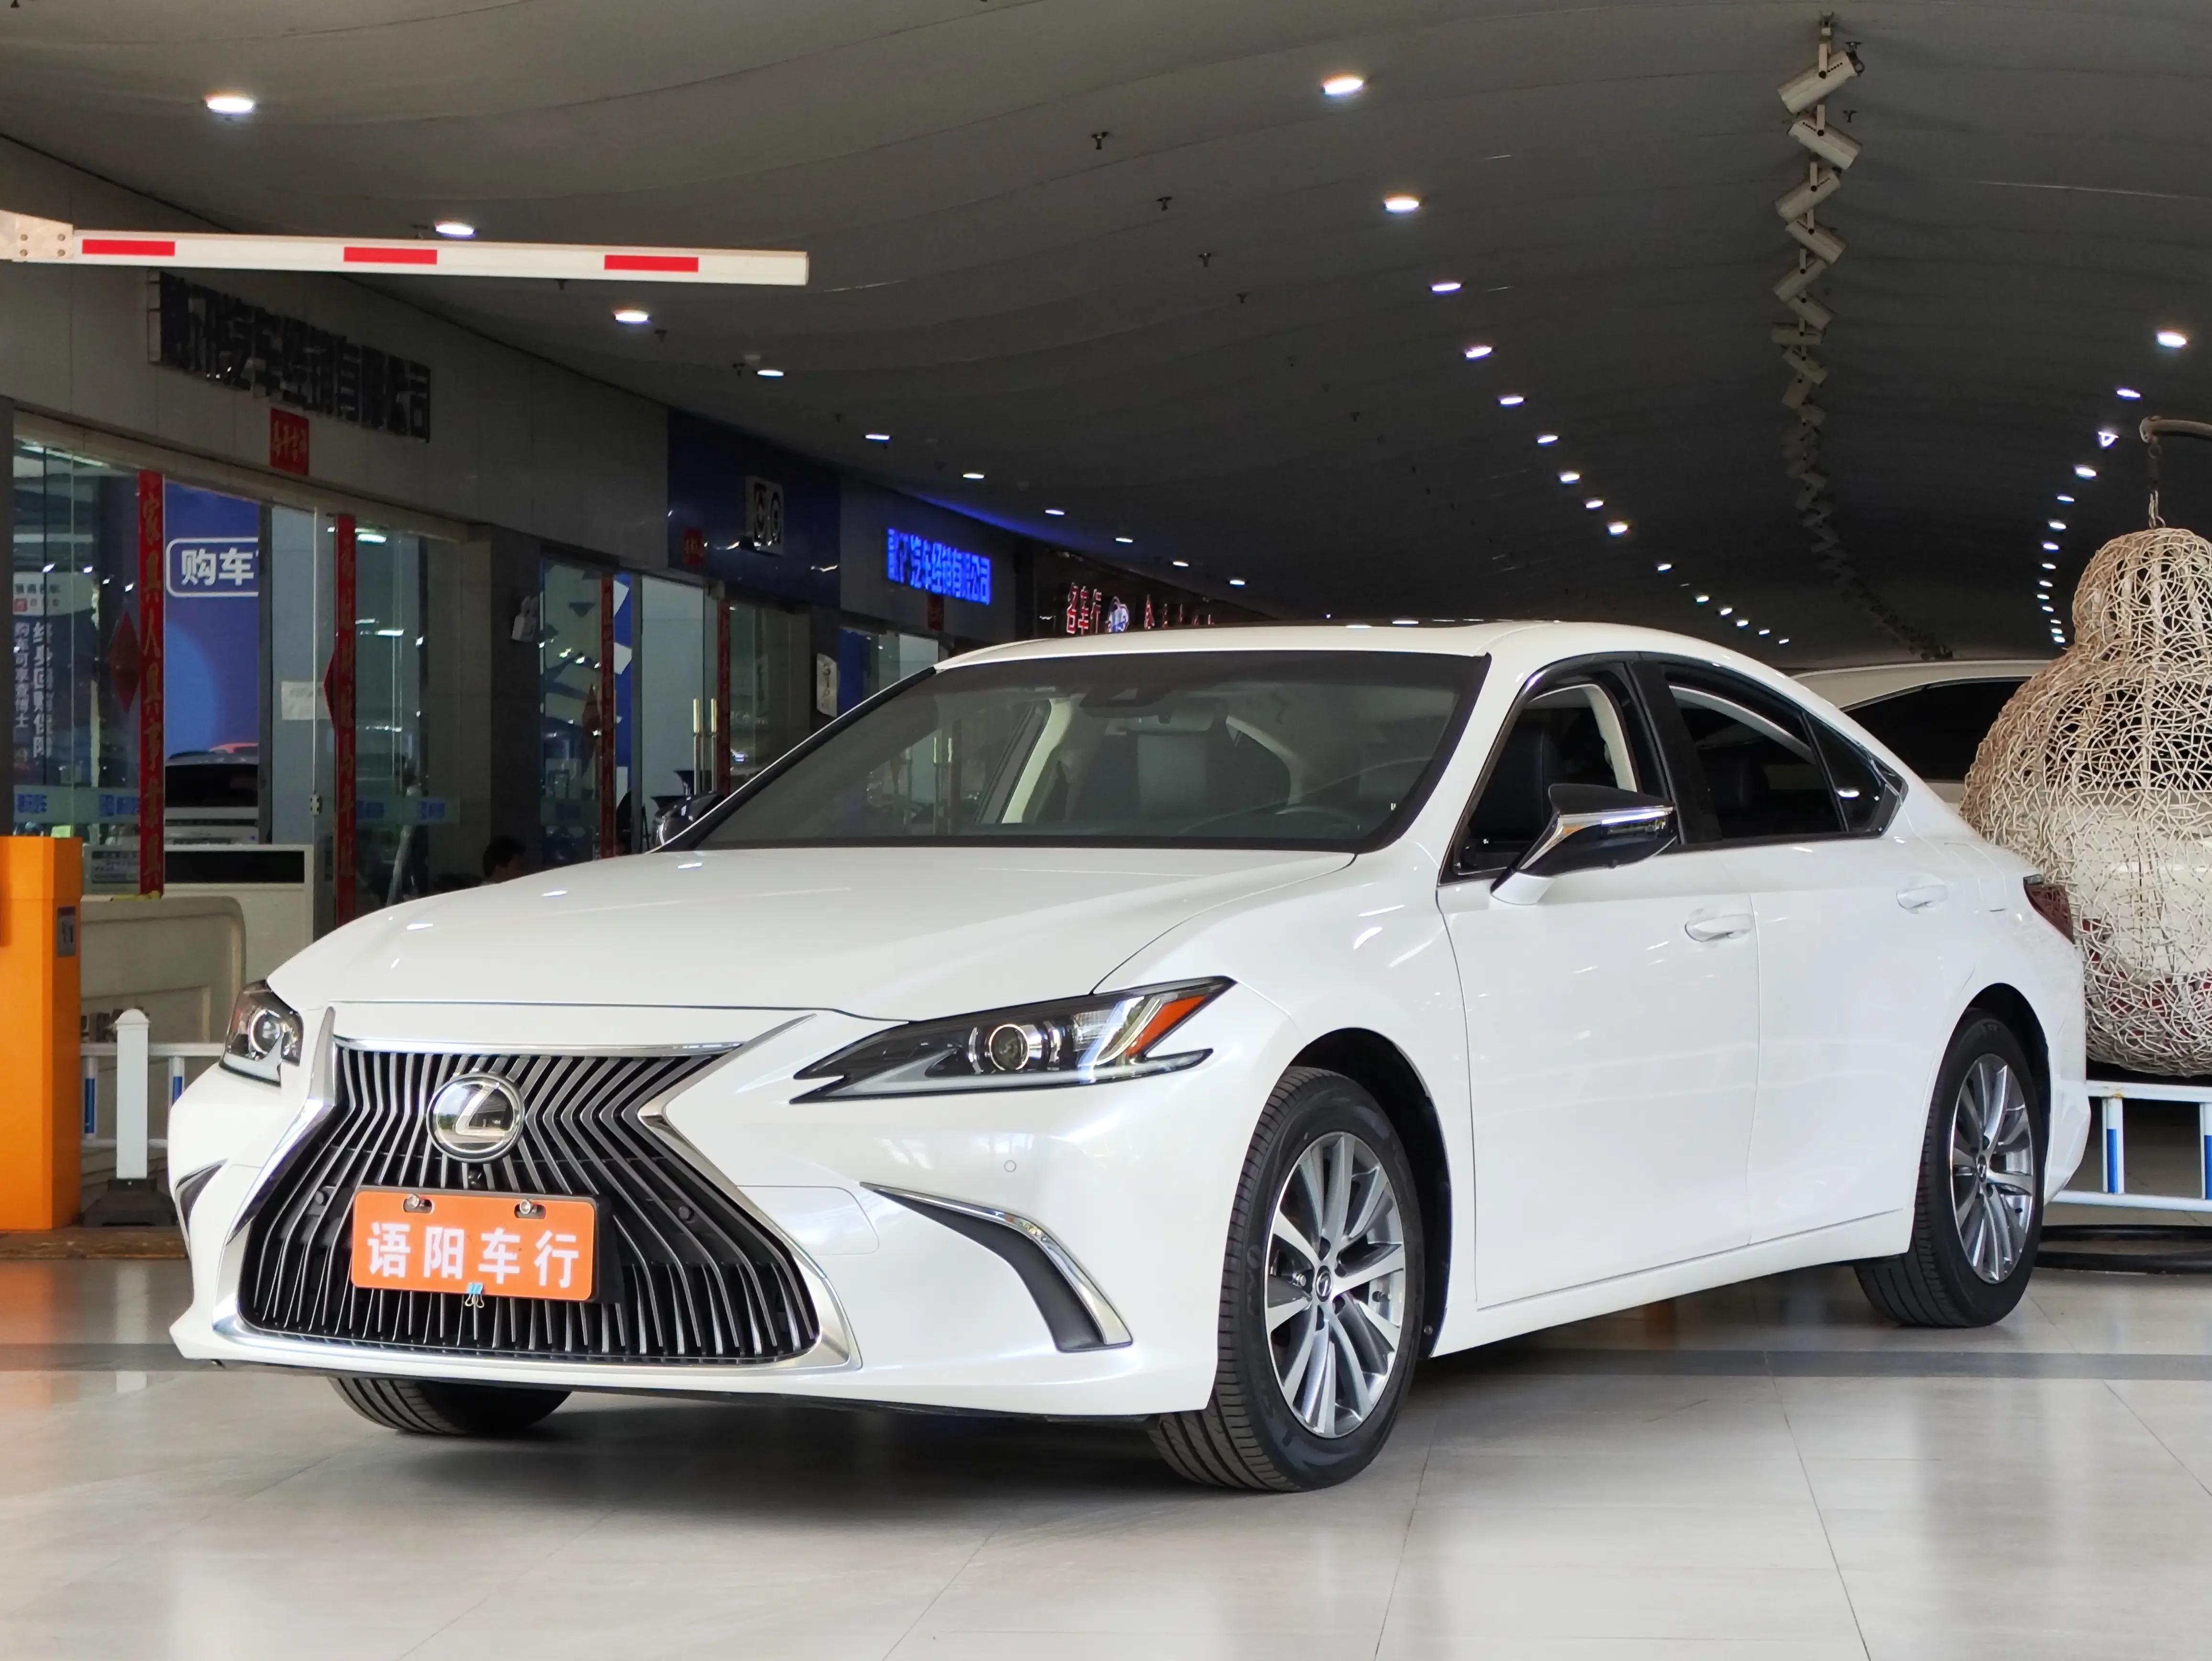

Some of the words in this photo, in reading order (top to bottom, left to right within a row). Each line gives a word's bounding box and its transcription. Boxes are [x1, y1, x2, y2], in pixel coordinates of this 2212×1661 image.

[181, 547, 259, 586] 购车
[367, 1221, 579, 1288] 语阳车行
